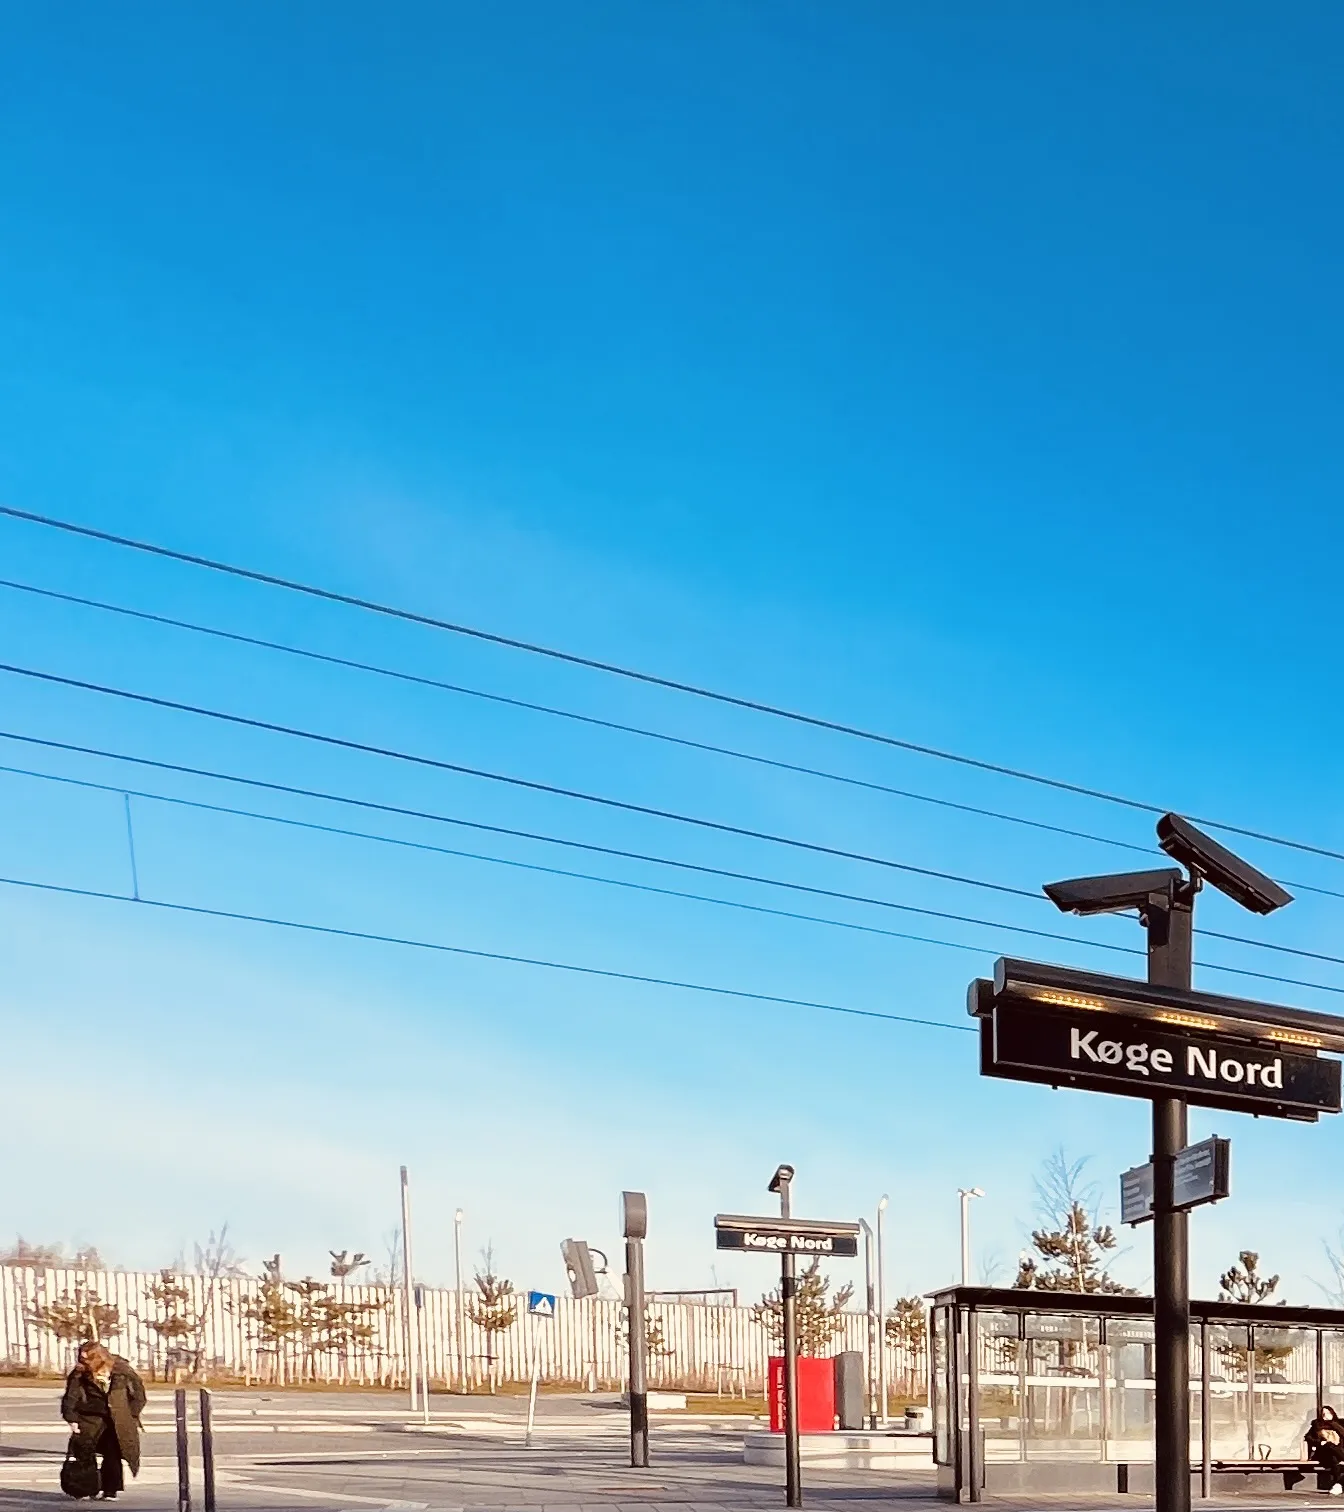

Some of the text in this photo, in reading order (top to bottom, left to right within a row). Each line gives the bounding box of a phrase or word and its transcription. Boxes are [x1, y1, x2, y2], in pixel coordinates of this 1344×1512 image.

[1070, 1027, 1284, 1089] Køge Nord
[791, 1235, 833, 1250] Nord
